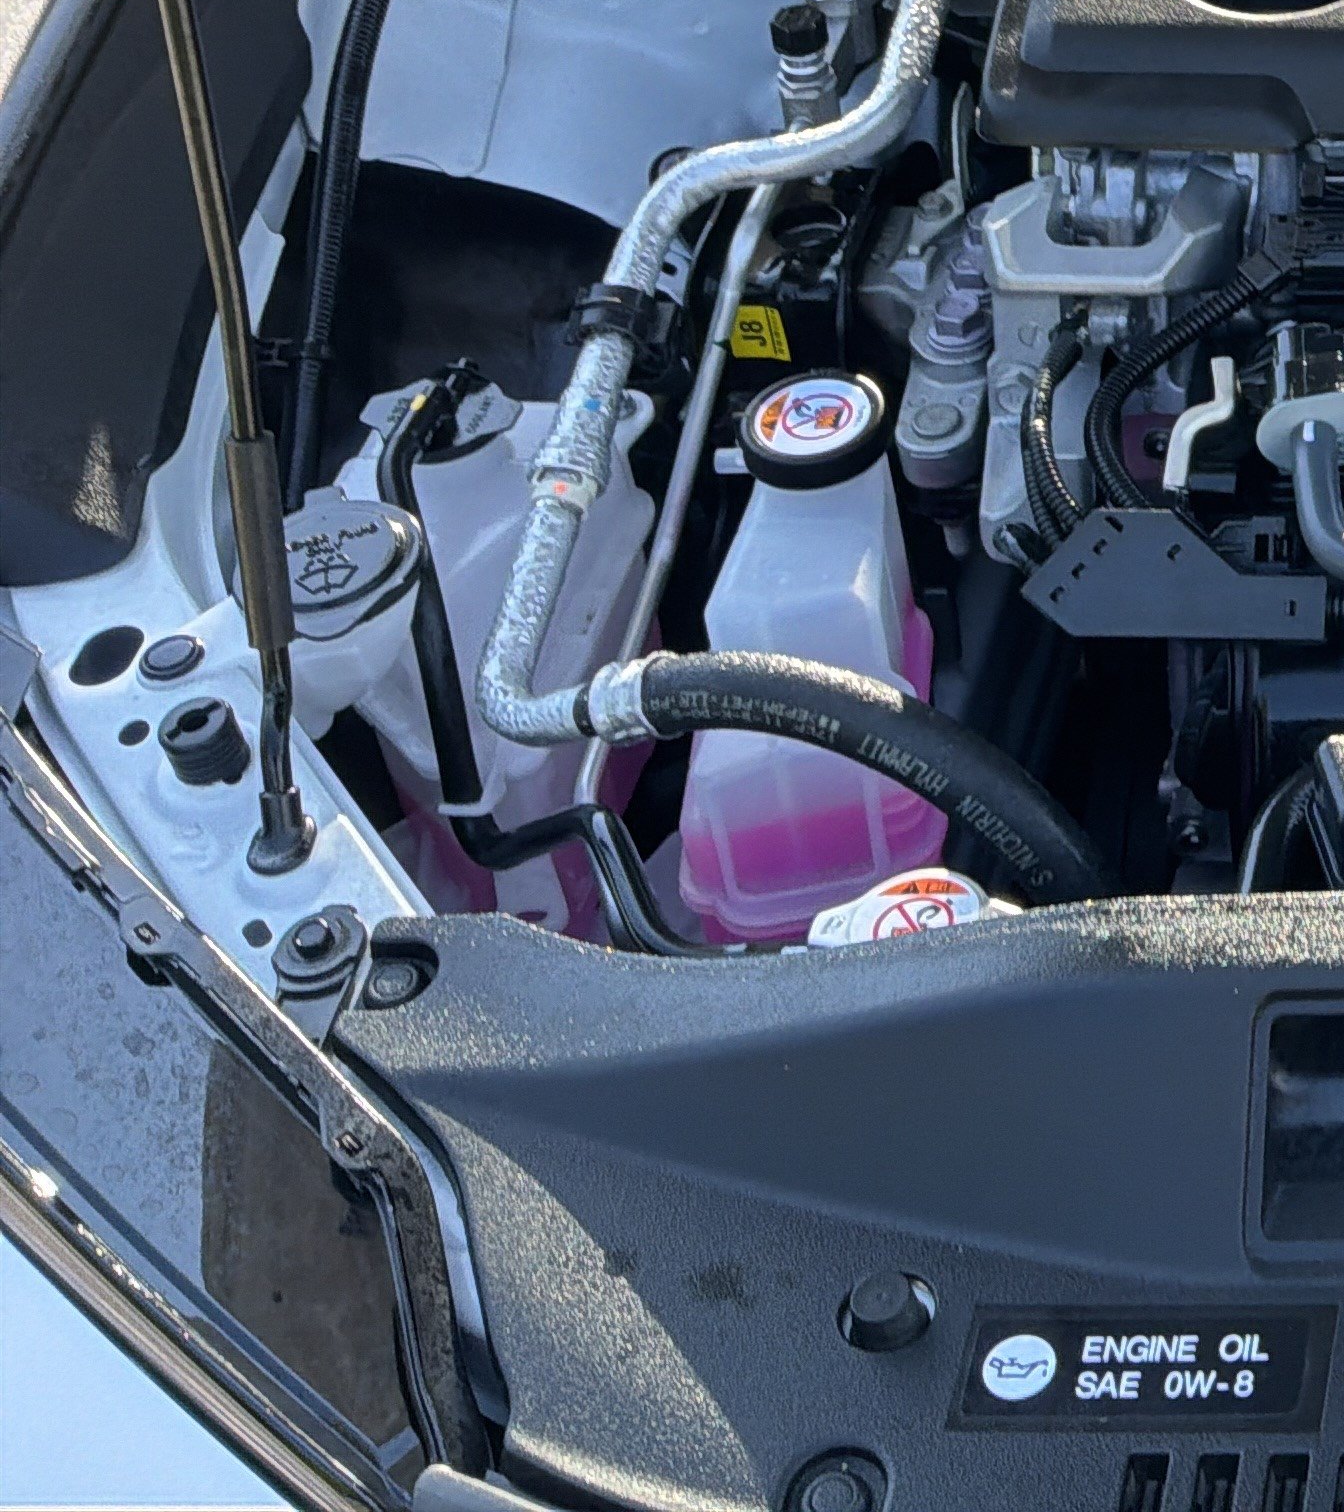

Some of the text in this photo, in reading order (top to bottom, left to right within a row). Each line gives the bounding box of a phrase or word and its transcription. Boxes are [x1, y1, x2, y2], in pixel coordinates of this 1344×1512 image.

[739, 320, 767, 347] J8
[1081, 1333, 1270, 1363] ENGINE OIL
[1074, 1369, 1255, 1400] SAE 0W-8
